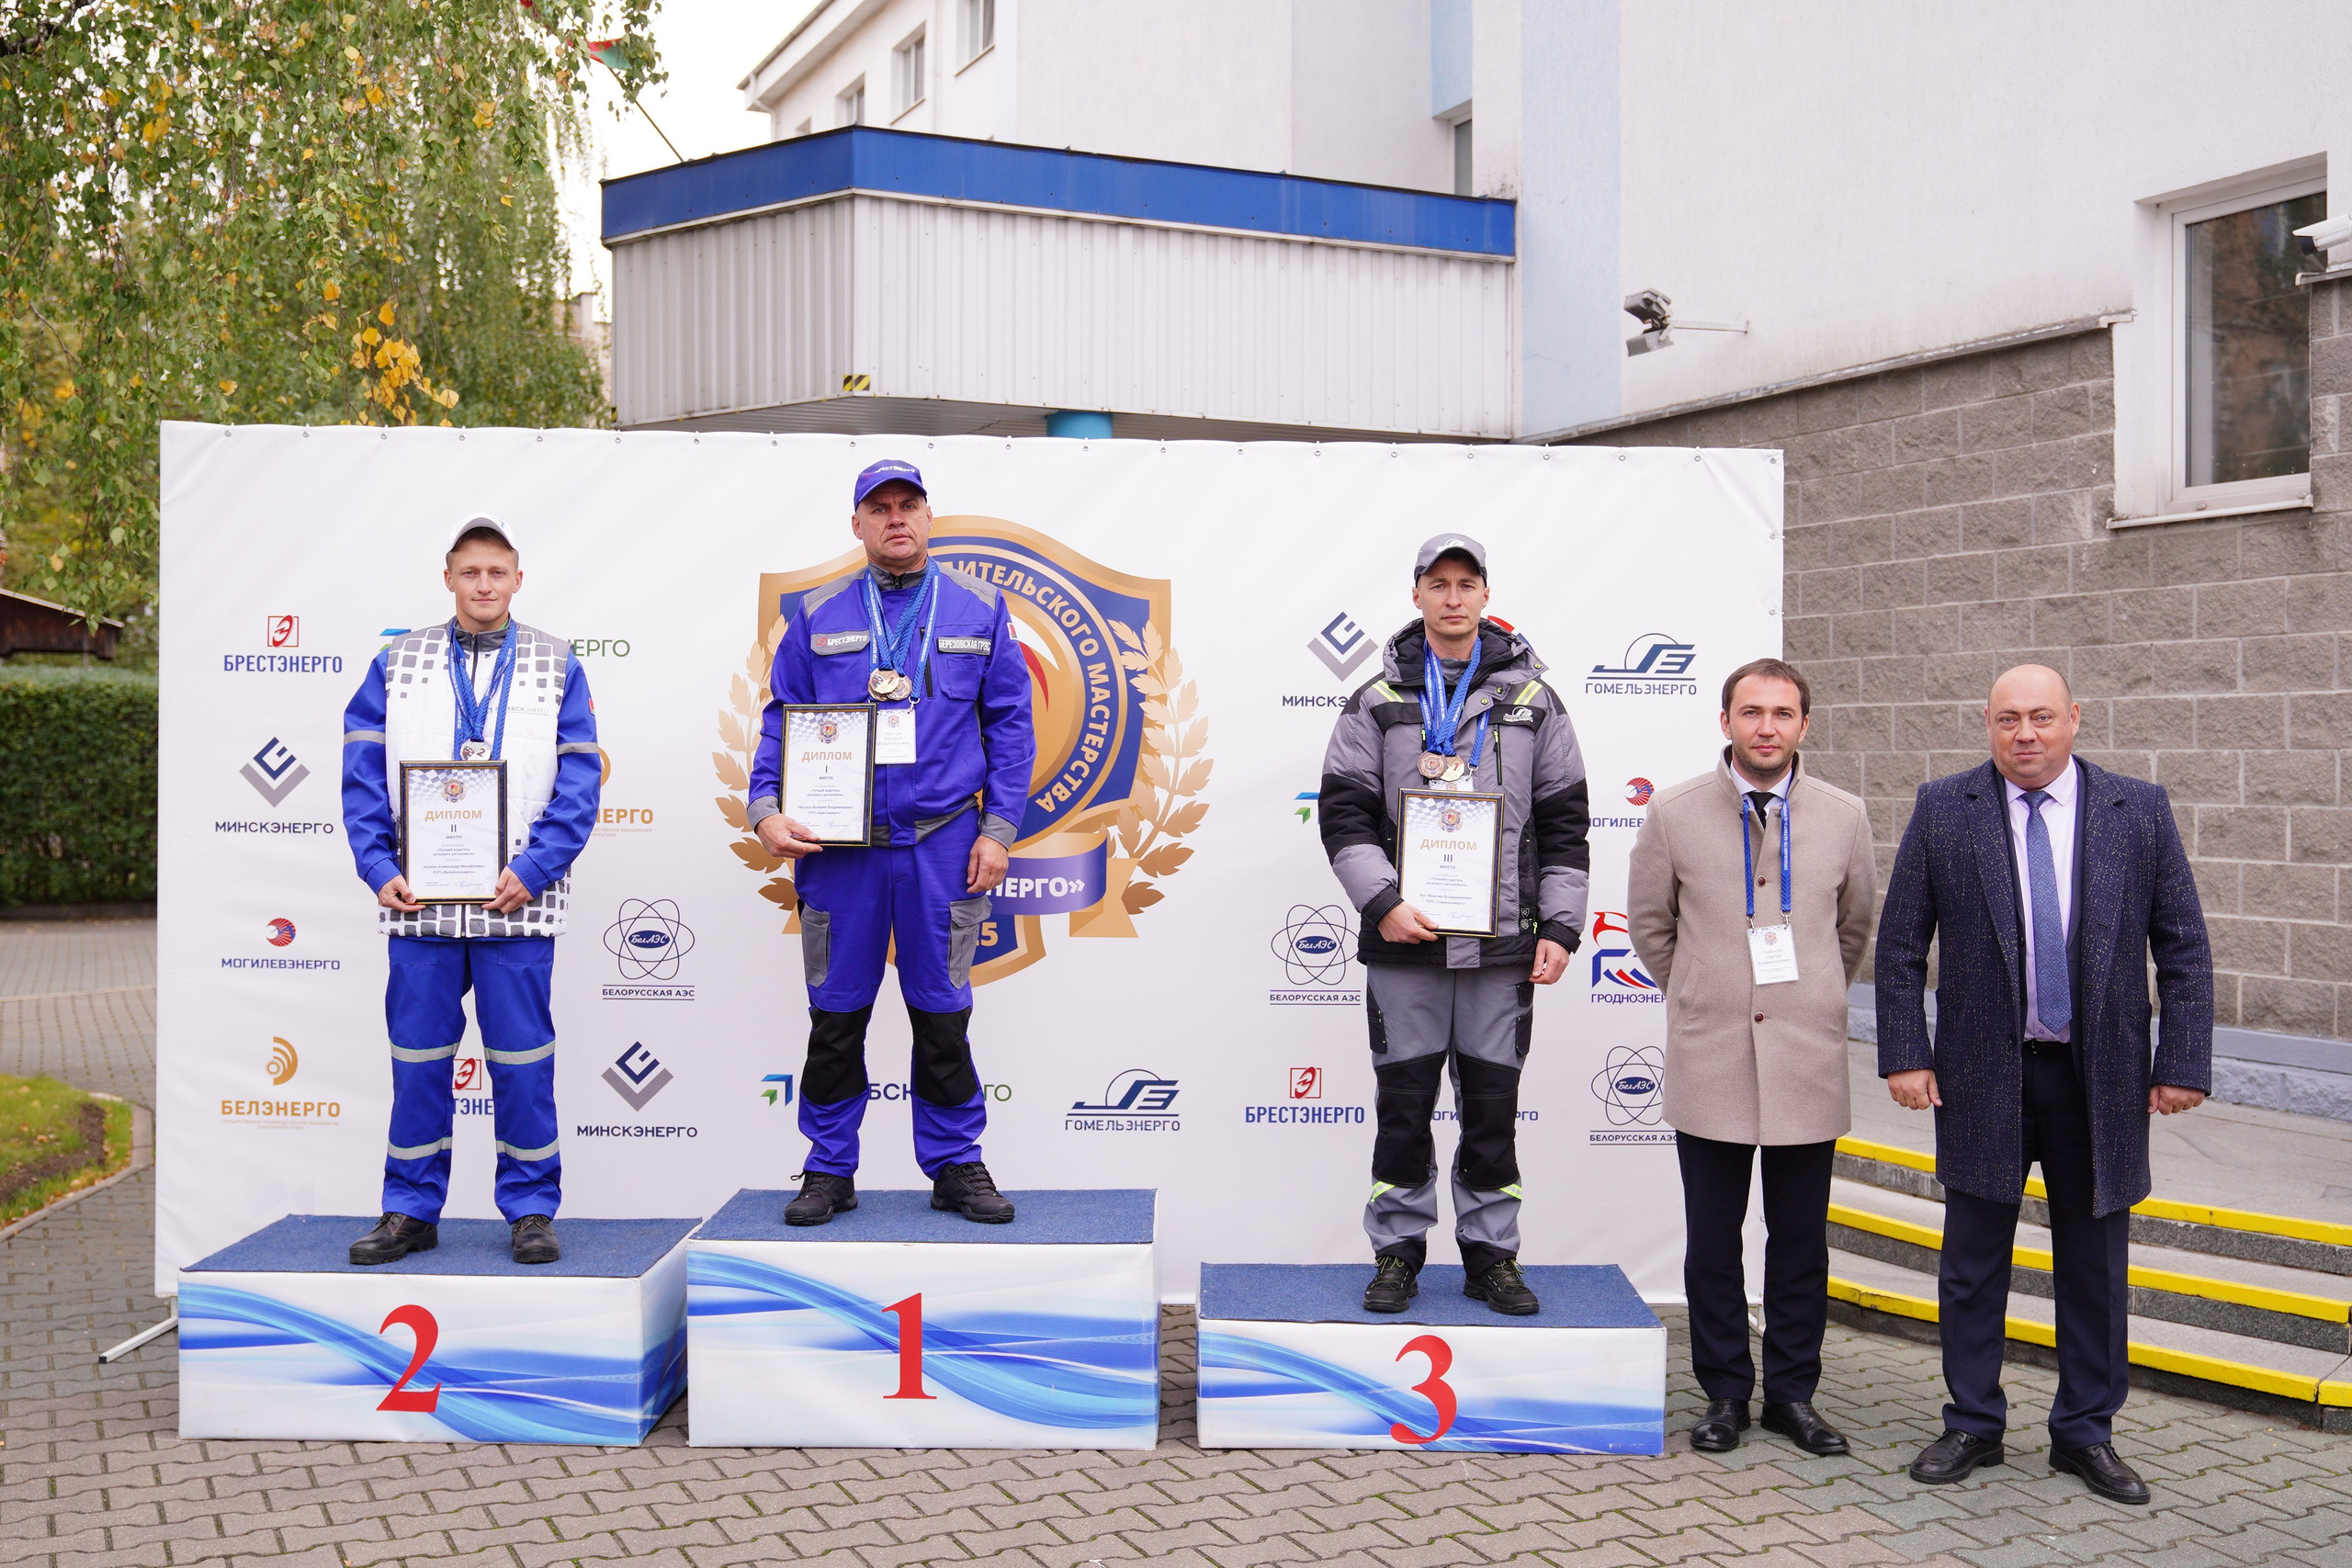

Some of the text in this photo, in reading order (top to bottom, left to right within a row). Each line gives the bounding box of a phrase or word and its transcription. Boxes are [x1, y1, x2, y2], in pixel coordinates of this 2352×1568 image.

[827, 635, 867, 646] БРЕСТЭНЕРГО
[938, 639, 978, 649] БЕРЕЗОВСКАЯ
[223, 654, 343, 673] БРЕСТЭНЕРГО
[941, 560, 1111, 814] ИТЕЛЬСКОГО МАСТЕРСТВА
[1585, 682, 1697, 694] ГОМЕЛЬЭНЕРГО
[1282, 695, 1348, 706] МИНСКЭ
[801, 751, 853, 762] ДИПЛОМ
[424, 810, 482, 822] ДИПЛОМ
[215, 820, 334, 835] МИНСКЭНЕРГО
[1419, 839, 1477, 851] ДИПЛОМ
[1443, 854, 1453, 863] III
[631, 934, 668, 943] БелАЭС
[1298, 940, 1334, 949] БелАЭС
[221, 958, 340, 970] МОГИЛЕВЭНЕРГО
[1618, 1080, 1653, 1090] БелАЭС
[221, 1100, 341, 1118] БЕЛЭНЕРГО
[1245, 1106, 1364, 1124] БРЕСТЭНЕРГО
[1065, 1119, 1181, 1131] ГОМЕЛЬЭНЕРГО
[577, 1125, 697, 1138] МИНСКЭНЕРГО
[880, 1292, 937, 1401] 1
[376, 1303, 442, 1413] 2
[1390, 1335, 1458, 1443] 3
